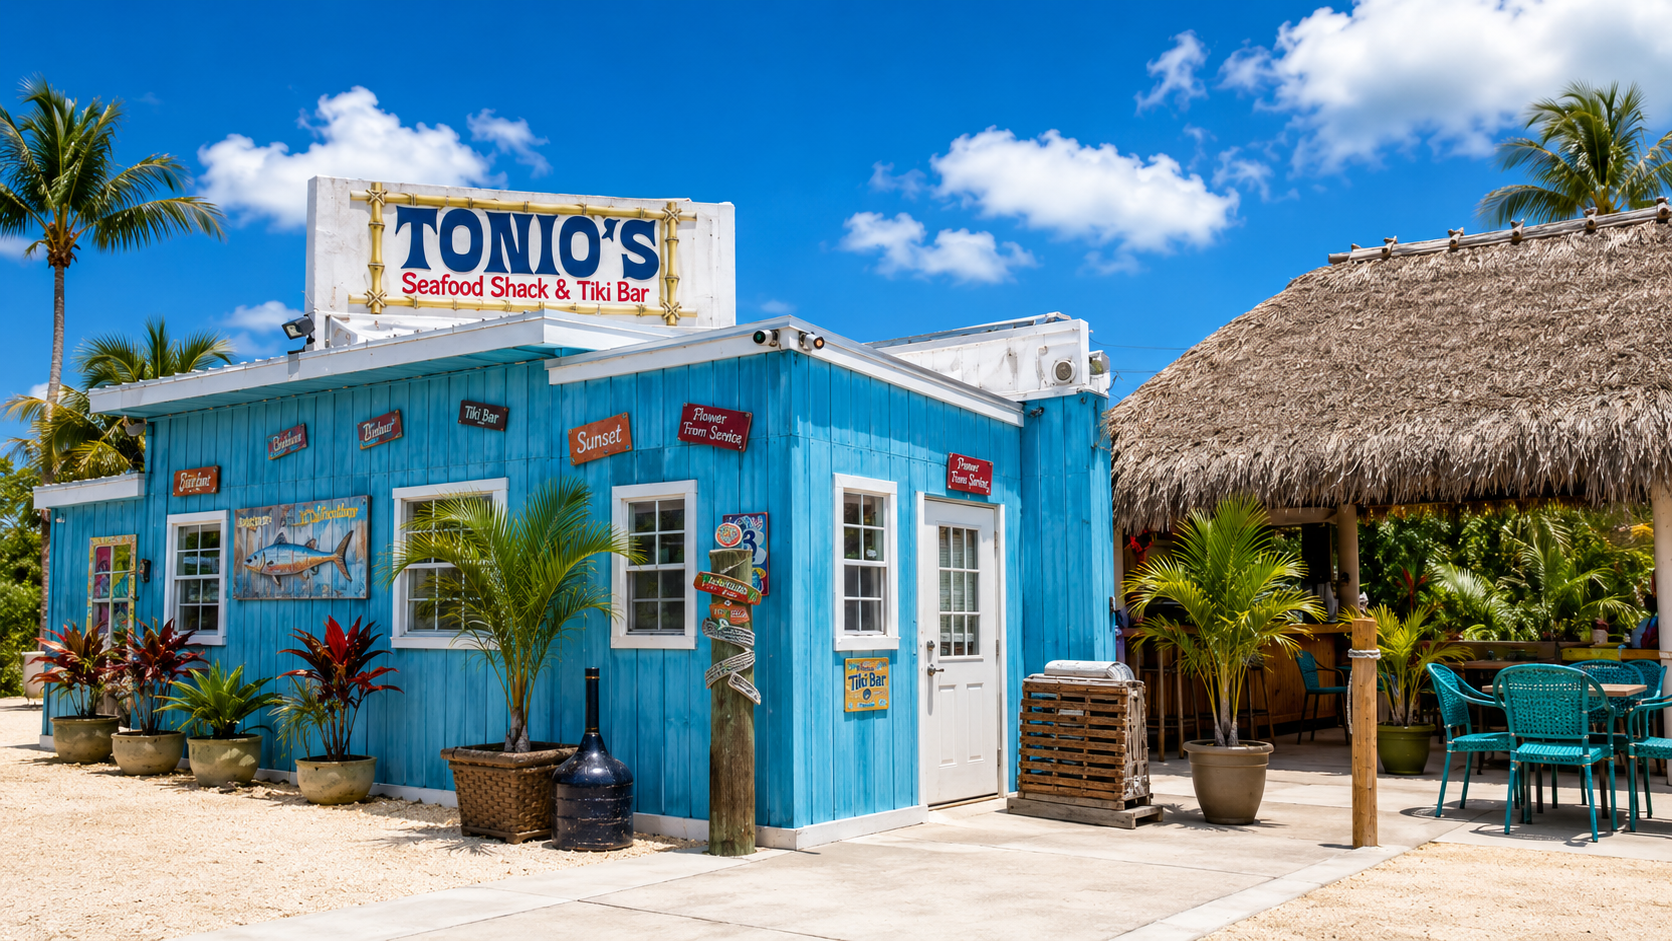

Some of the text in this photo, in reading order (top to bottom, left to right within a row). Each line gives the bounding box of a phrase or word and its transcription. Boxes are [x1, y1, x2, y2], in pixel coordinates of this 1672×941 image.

[395, 205, 659, 281] TONIO'S
[402, 272, 650, 303] Seafood Shack & Tiki Bar
[465, 405, 500, 424] Tiki Bar
[577, 424, 622, 454] Sunset
[847, 671, 887, 691] Tiki Bar
